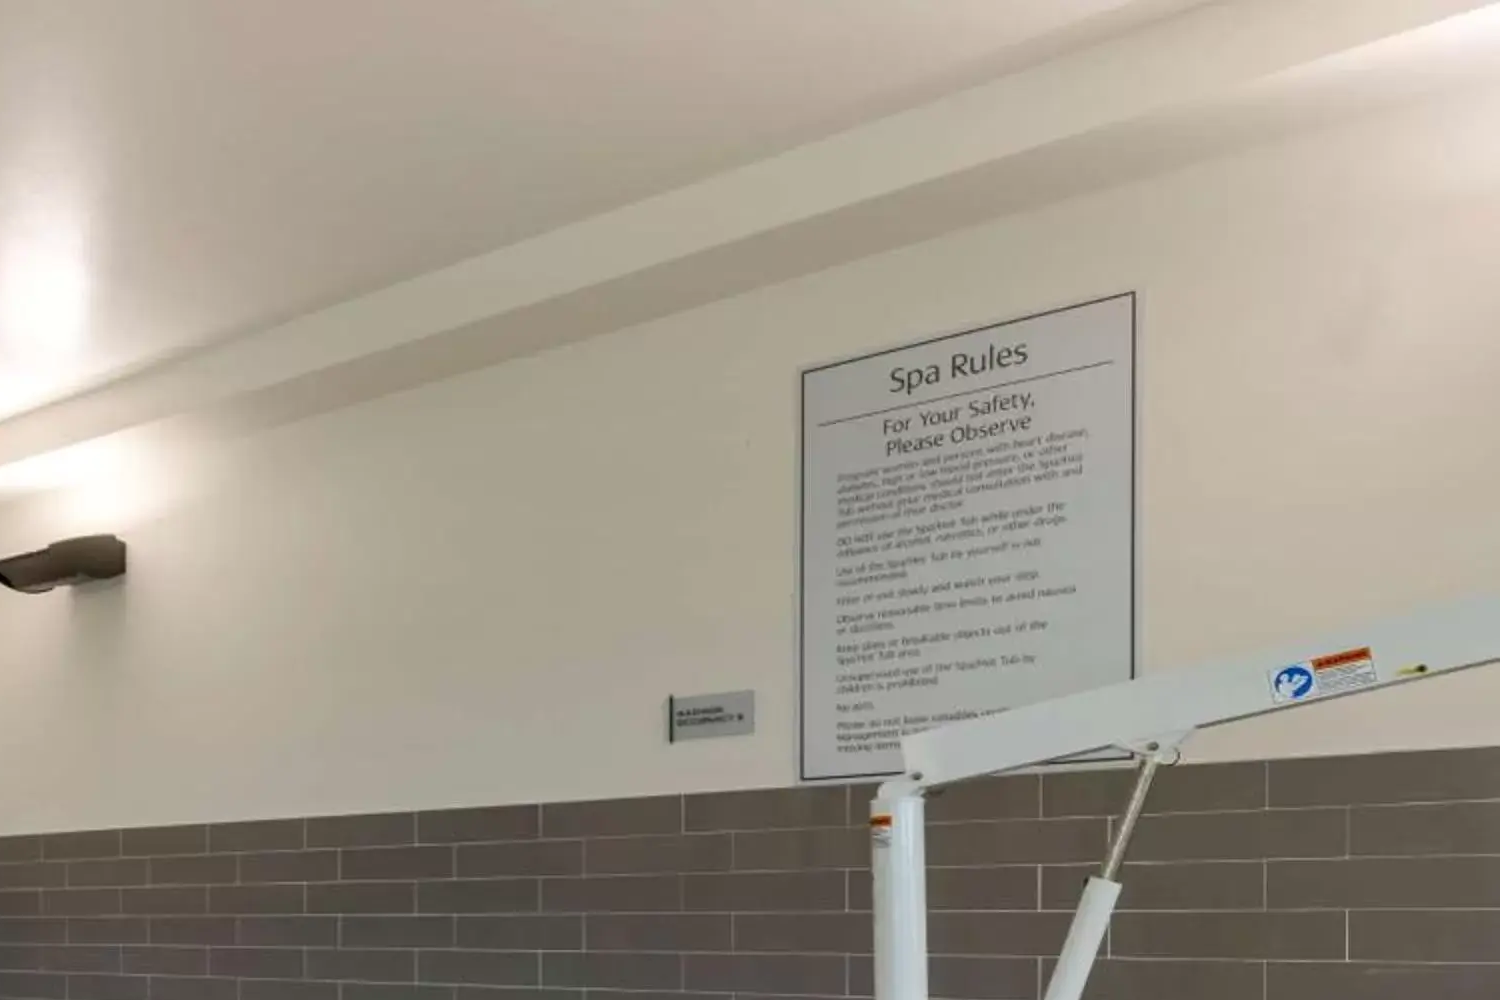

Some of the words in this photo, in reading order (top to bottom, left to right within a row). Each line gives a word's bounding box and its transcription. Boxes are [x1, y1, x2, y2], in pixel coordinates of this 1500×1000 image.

[889, 362, 941, 395] Spa
[951, 343, 1028, 378] Rules
[883, 419, 912, 436] For
[919, 407, 961, 427] Your
[969, 393, 1035, 420] Safety,
[886, 434, 944, 457] Please
[950, 415, 1032, 444] Observe
